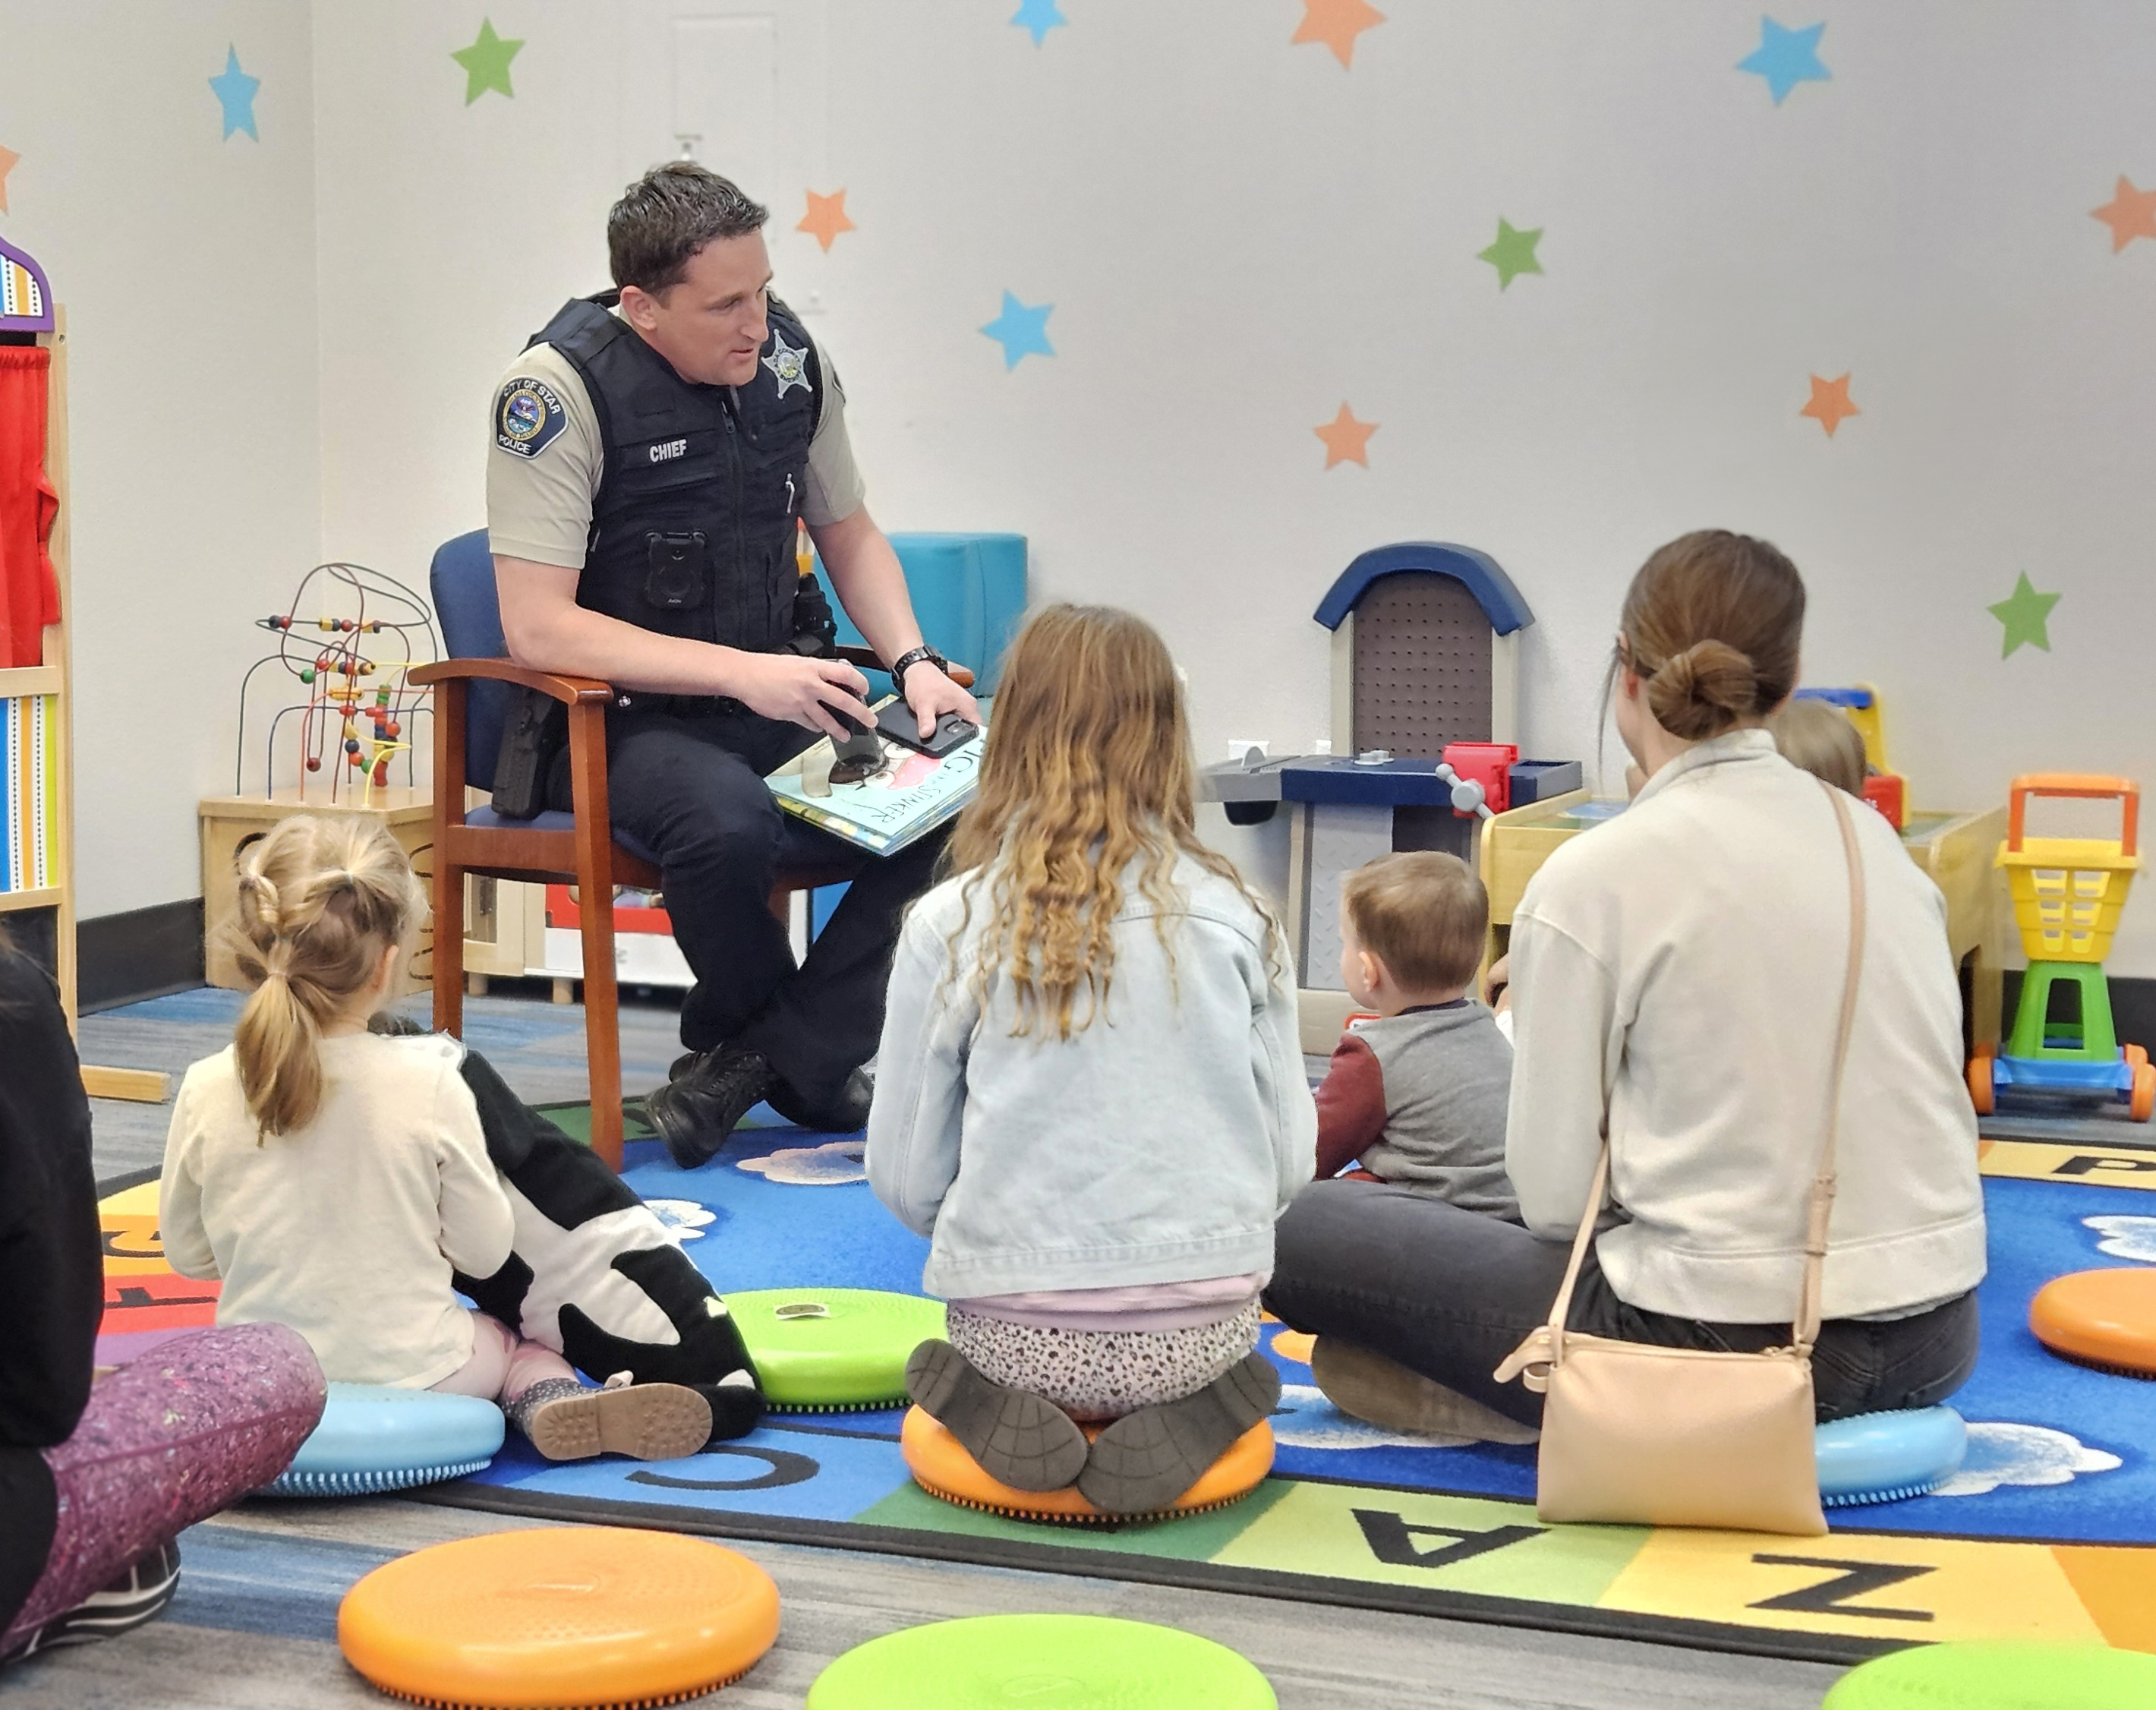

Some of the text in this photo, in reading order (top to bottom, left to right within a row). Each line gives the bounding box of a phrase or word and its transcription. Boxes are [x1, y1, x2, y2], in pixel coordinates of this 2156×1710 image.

[503, 380, 562, 415] CITY OF STAR
[498, 434, 532, 455] POLICE
[649, 438, 687, 463] CHIEF
[944, 738, 988, 773] IG
[871, 785, 941, 823] STINKER
[624, 1444, 820, 1491] C
[1349, 1508, 1553, 1569] A
